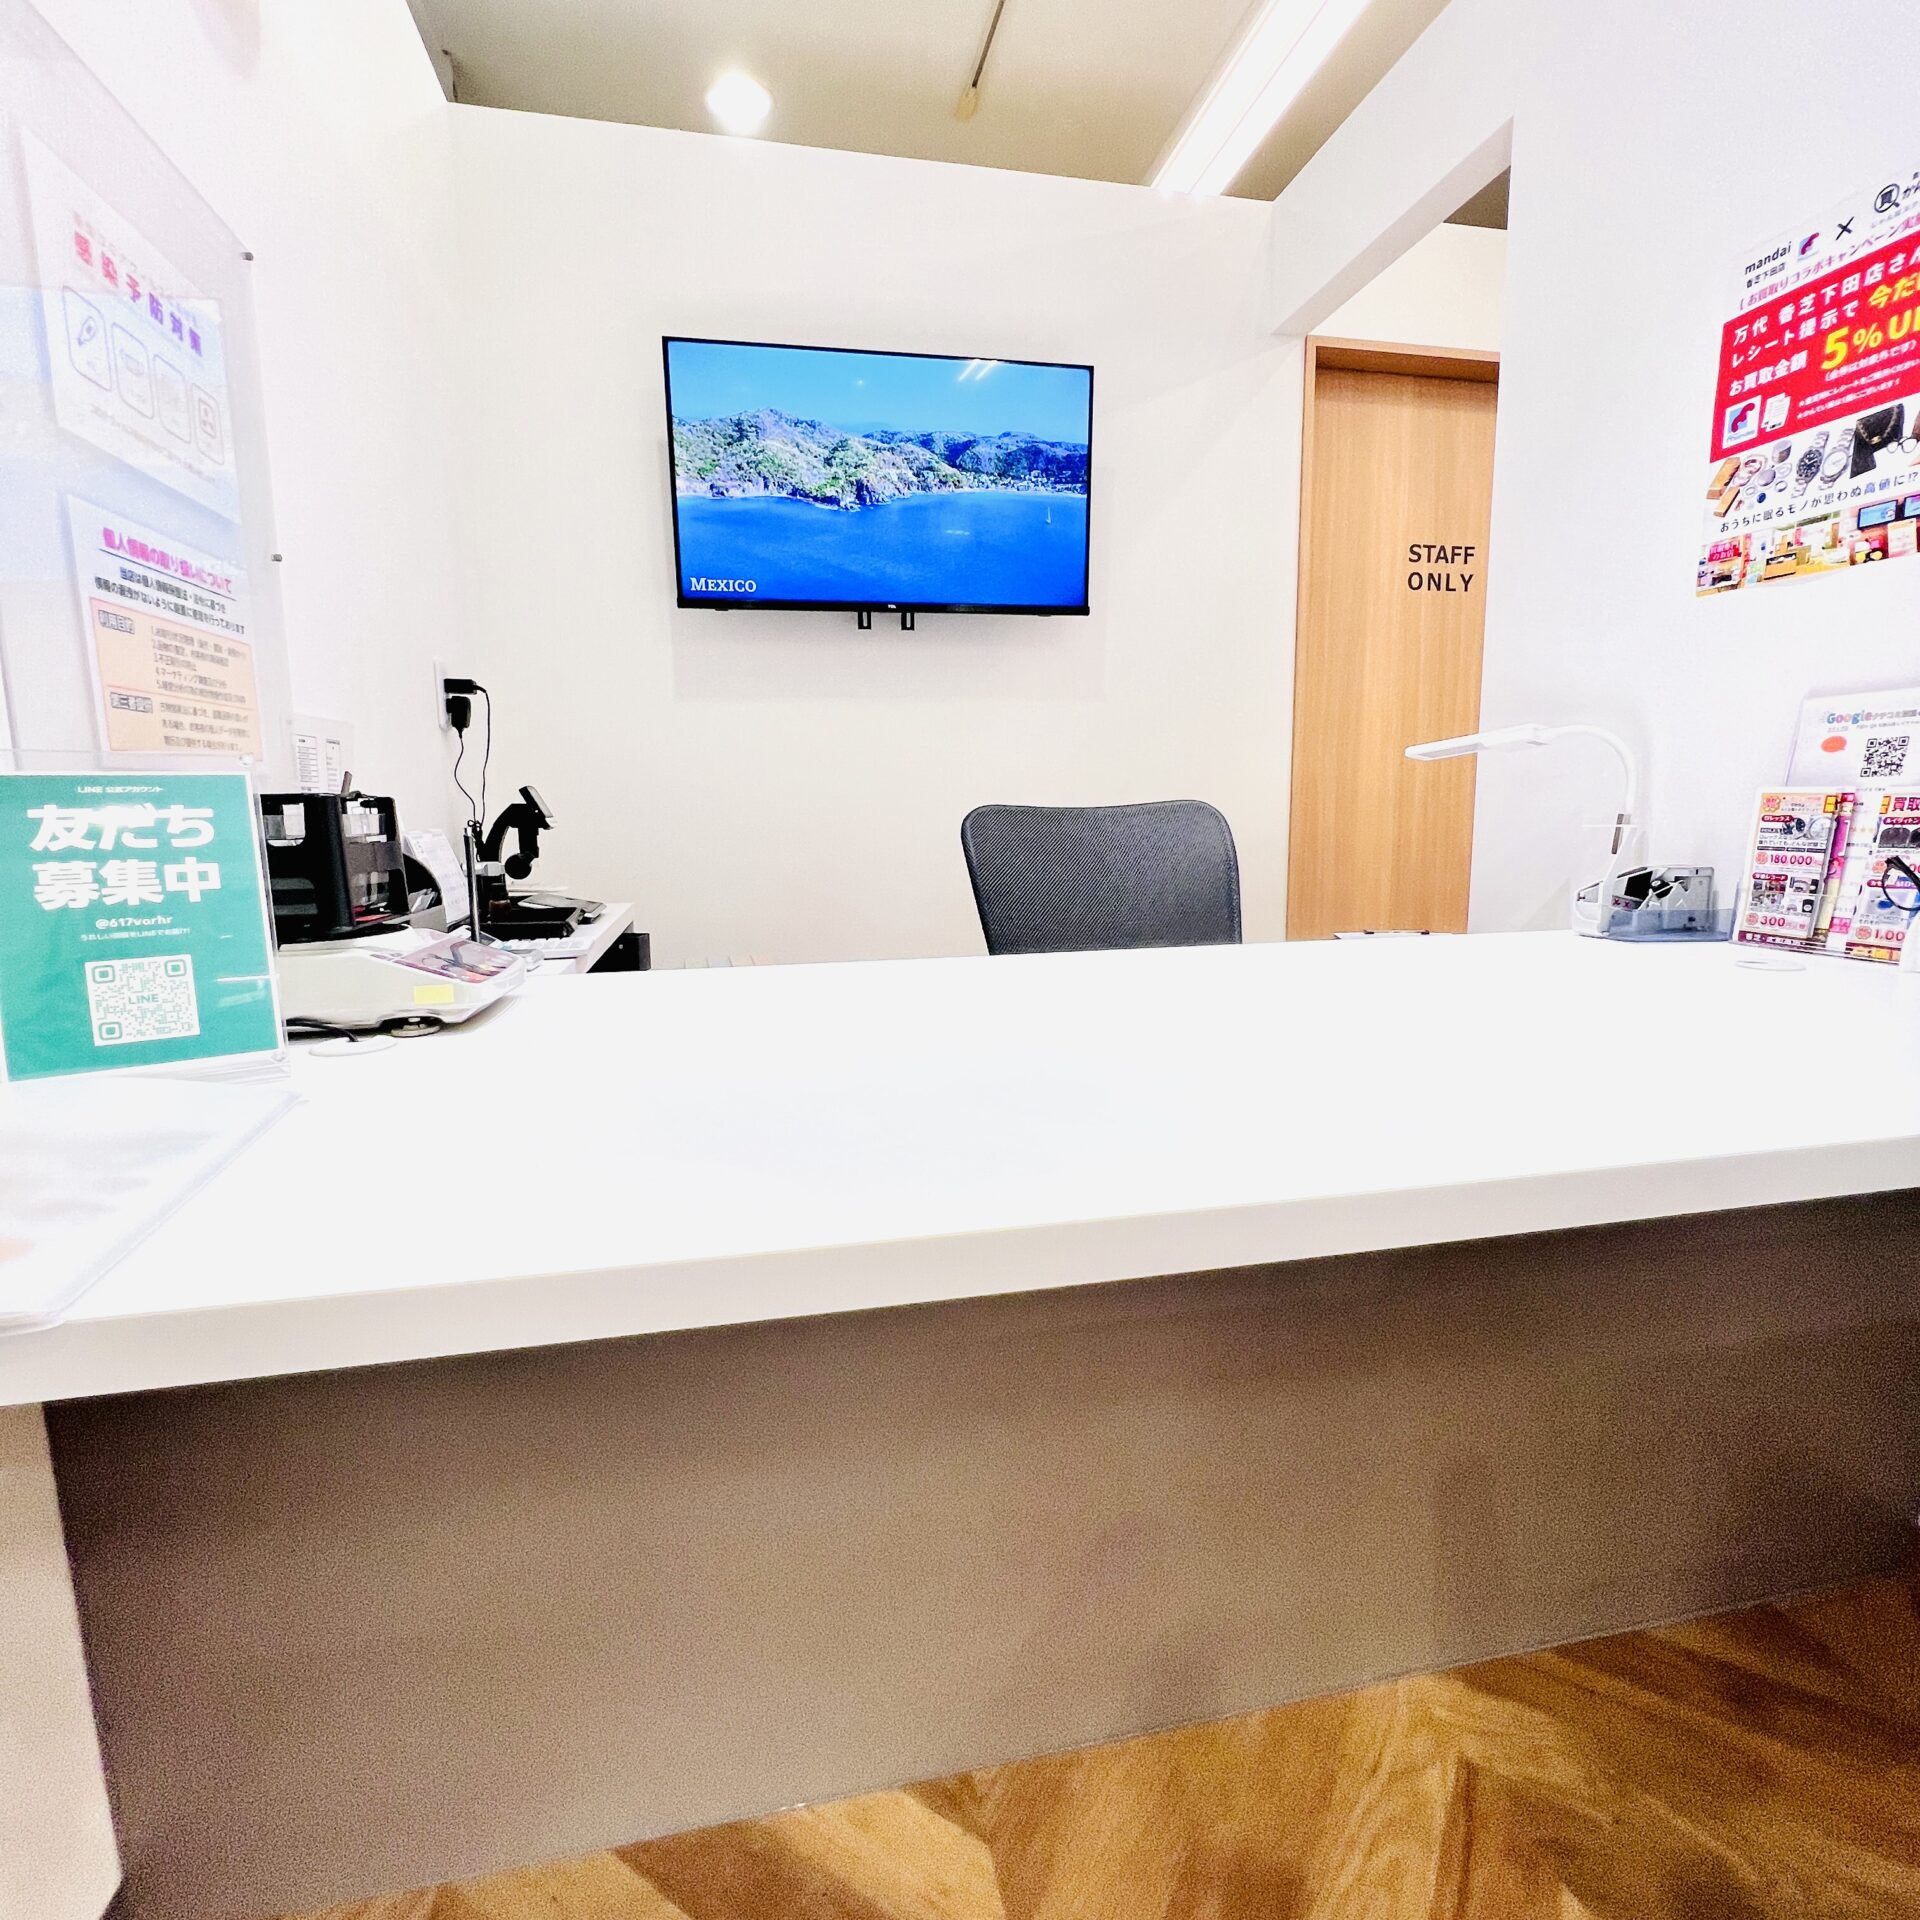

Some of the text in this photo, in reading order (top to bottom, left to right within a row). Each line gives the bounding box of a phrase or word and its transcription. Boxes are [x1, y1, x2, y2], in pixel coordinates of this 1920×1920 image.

[1744, 241, 1792, 275] mandai
[1732, 272, 1920, 369] レシート提示で 今だ
[1733, 315, 1768, 346] 万代
[1408, 543, 1475, 565] STAFF
[690, 576, 757, 593] MEXICO
[1407, 571, 1474, 593] ONLY
[1826, 709, 1872, 725] Google
[27, 803, 214, 851] 友だち
[32, 856, 222, 911] 募集中
[1760, 915, 1786, 927] 300
[128, 993, 160, 1005] LINE
